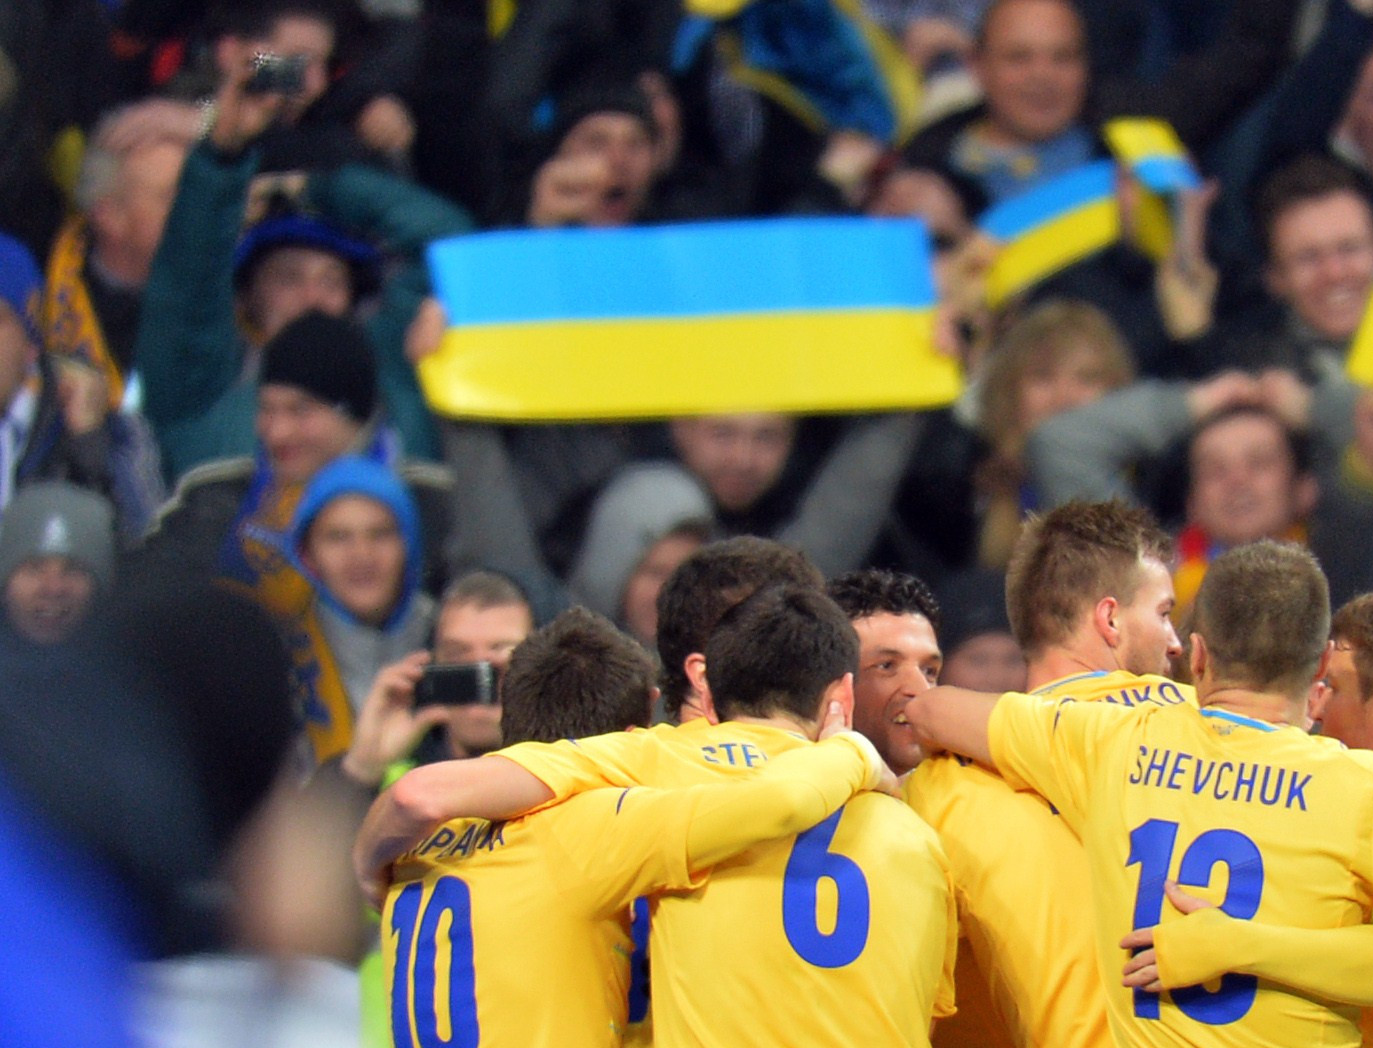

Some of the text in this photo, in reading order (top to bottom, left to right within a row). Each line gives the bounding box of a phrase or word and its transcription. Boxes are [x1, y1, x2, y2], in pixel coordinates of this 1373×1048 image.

[1129, 745, 1313, 811] SHEVCHUK
[782, 804, 871, 969] 6
[1124, 817, 1265, 1026] 13
